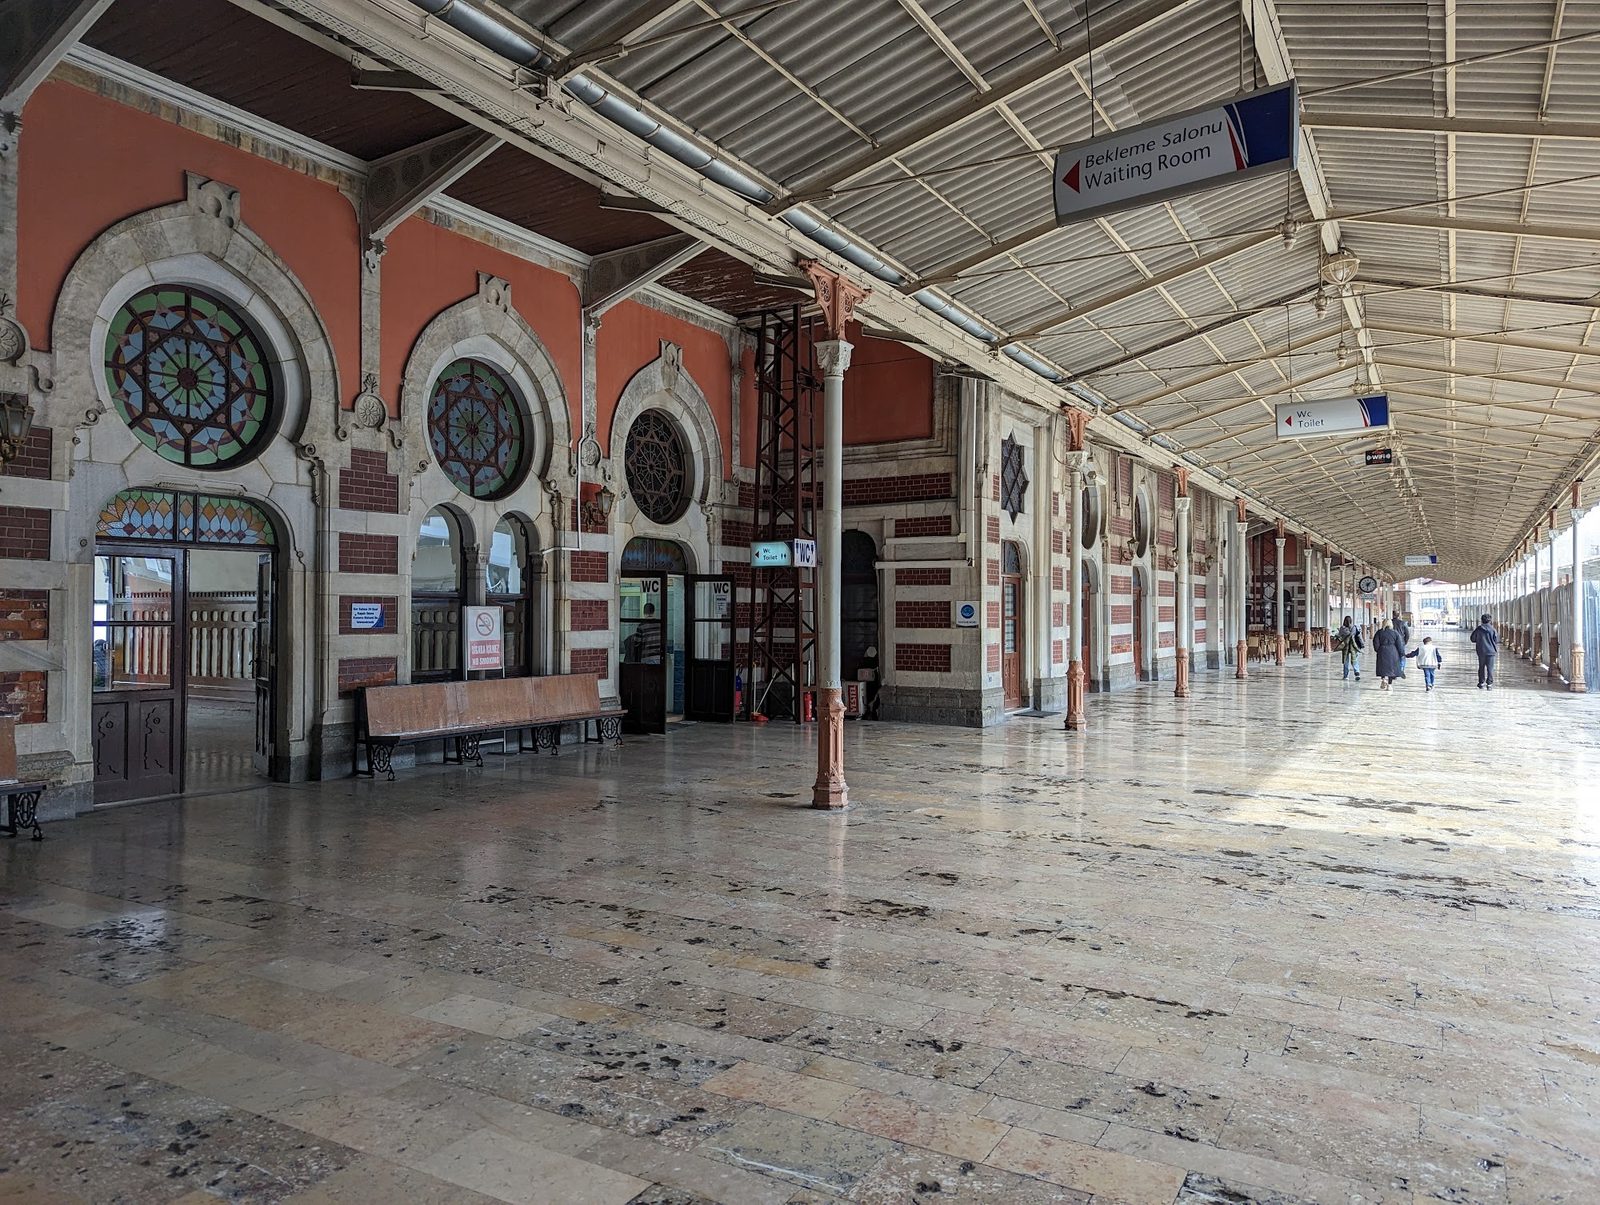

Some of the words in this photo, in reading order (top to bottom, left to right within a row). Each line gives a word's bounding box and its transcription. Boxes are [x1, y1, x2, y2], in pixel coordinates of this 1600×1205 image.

[1085, 140, 1156, 169] Bekleme
[1162, 121, 1223, 148] Salonu
[1084, 161, 1152, 190] Waiting
[1158, 145, 1211, 171] Room
[1298, 418, 1325, 428] Toilet
[799, 543, 811, 563] WC
[641, 580, 659, 593] WC
[713, 582, 729, 594] WC
